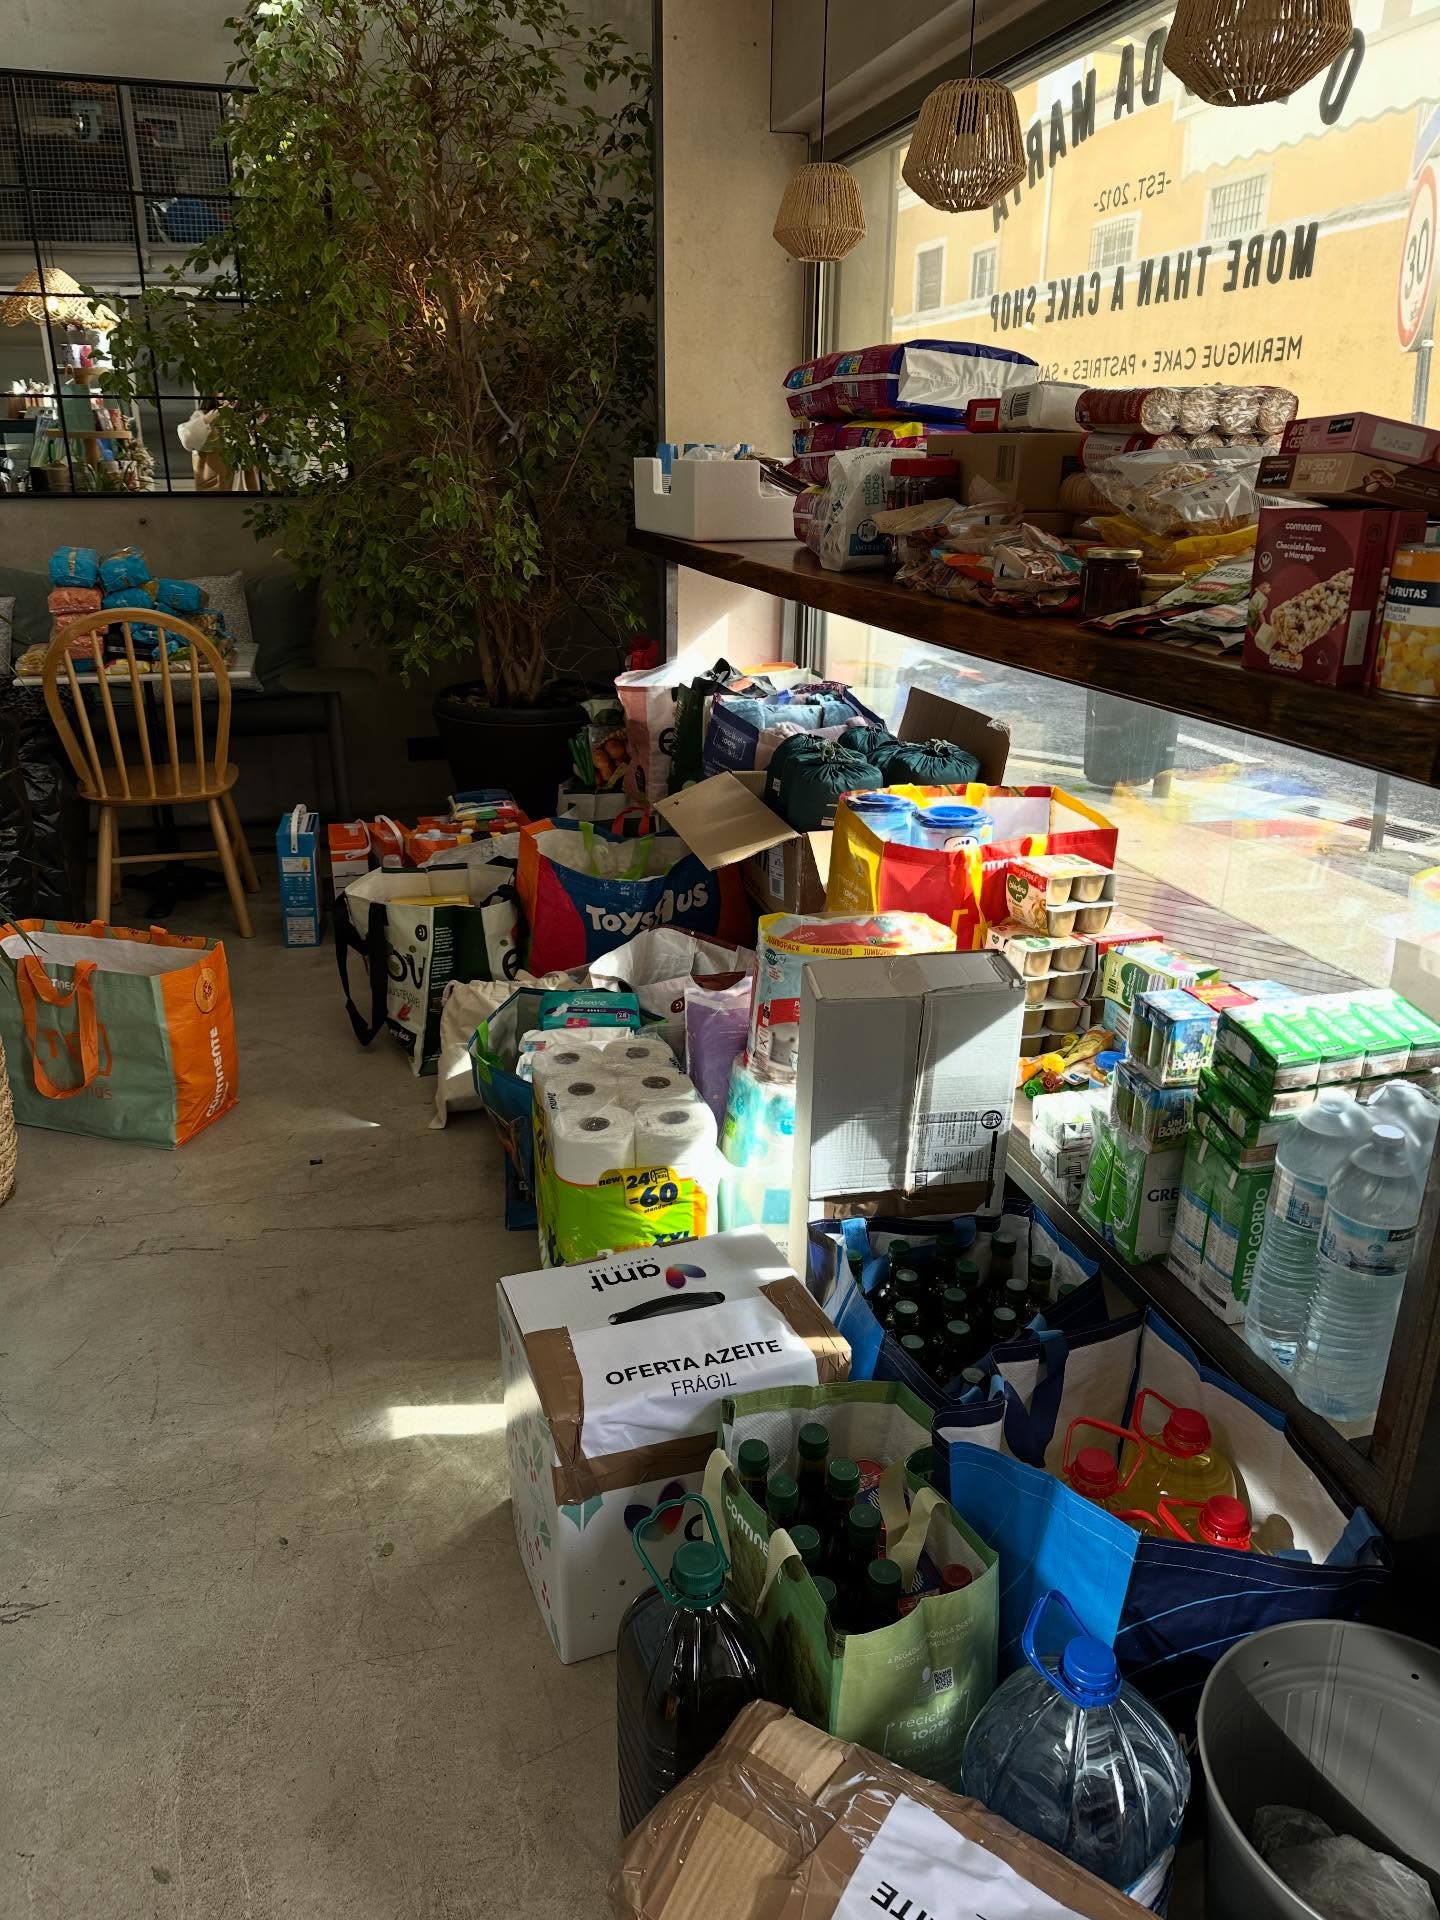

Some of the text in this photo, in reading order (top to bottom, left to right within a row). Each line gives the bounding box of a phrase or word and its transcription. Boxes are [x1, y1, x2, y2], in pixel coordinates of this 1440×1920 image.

[1404, 217, 1429, 300] 30
[1276, 541, 1327, 553] Chocolate Branco
[1289, 551, 1315, 562] Morango
[1395, 586, 1427, 599] FRUTAS
[585, 904, 655, 935] Toys
[821, 947, 853, 955] UNIDADES
[1106, 978, 1117, 993] BIO
[1173, 1056, 1211, 1070] BONGO
[1158, 1122, 1191, 1138] BONGO
[1168, 1118, 1183, 1128] UM
[626, 1172, 650, 1189] 24
[1248, 1187, 1268, 1249] GORDO
[591, 1264, 661, 1293] amt
[605, 1339, 783, 1385] OFERTA AZEITE
[671, 1372, 737, 1396] FRÁGIL
